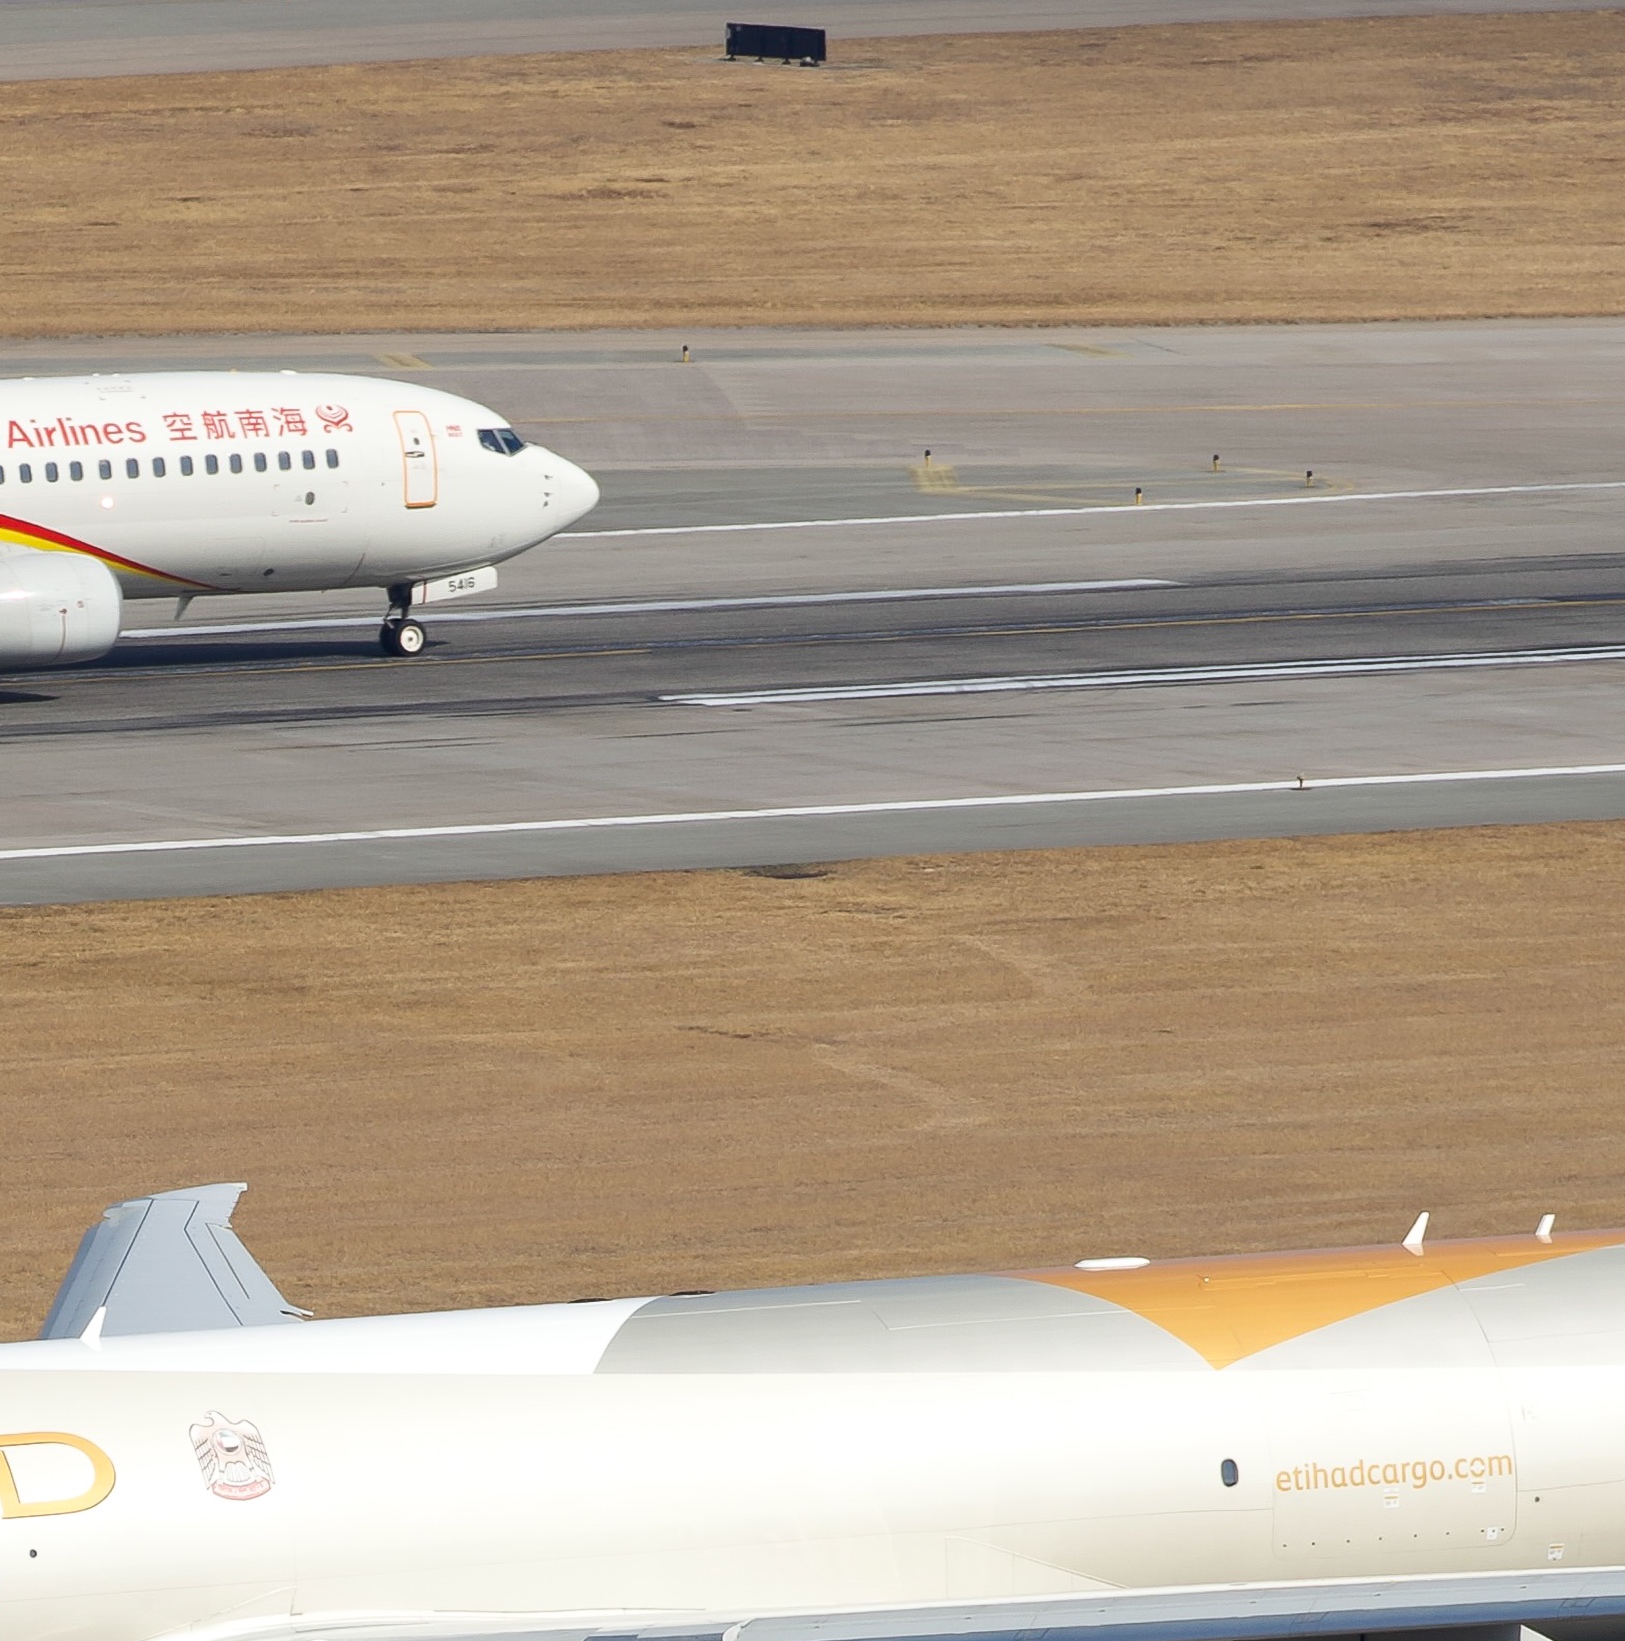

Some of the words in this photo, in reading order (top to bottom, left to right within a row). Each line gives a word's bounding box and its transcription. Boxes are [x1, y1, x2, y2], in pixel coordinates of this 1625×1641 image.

[7, 416, 147, 449] Airlines
[448, 576, 476, 592] 5416
[1275, 1452, 1513, 1492] etihadcargo.com
